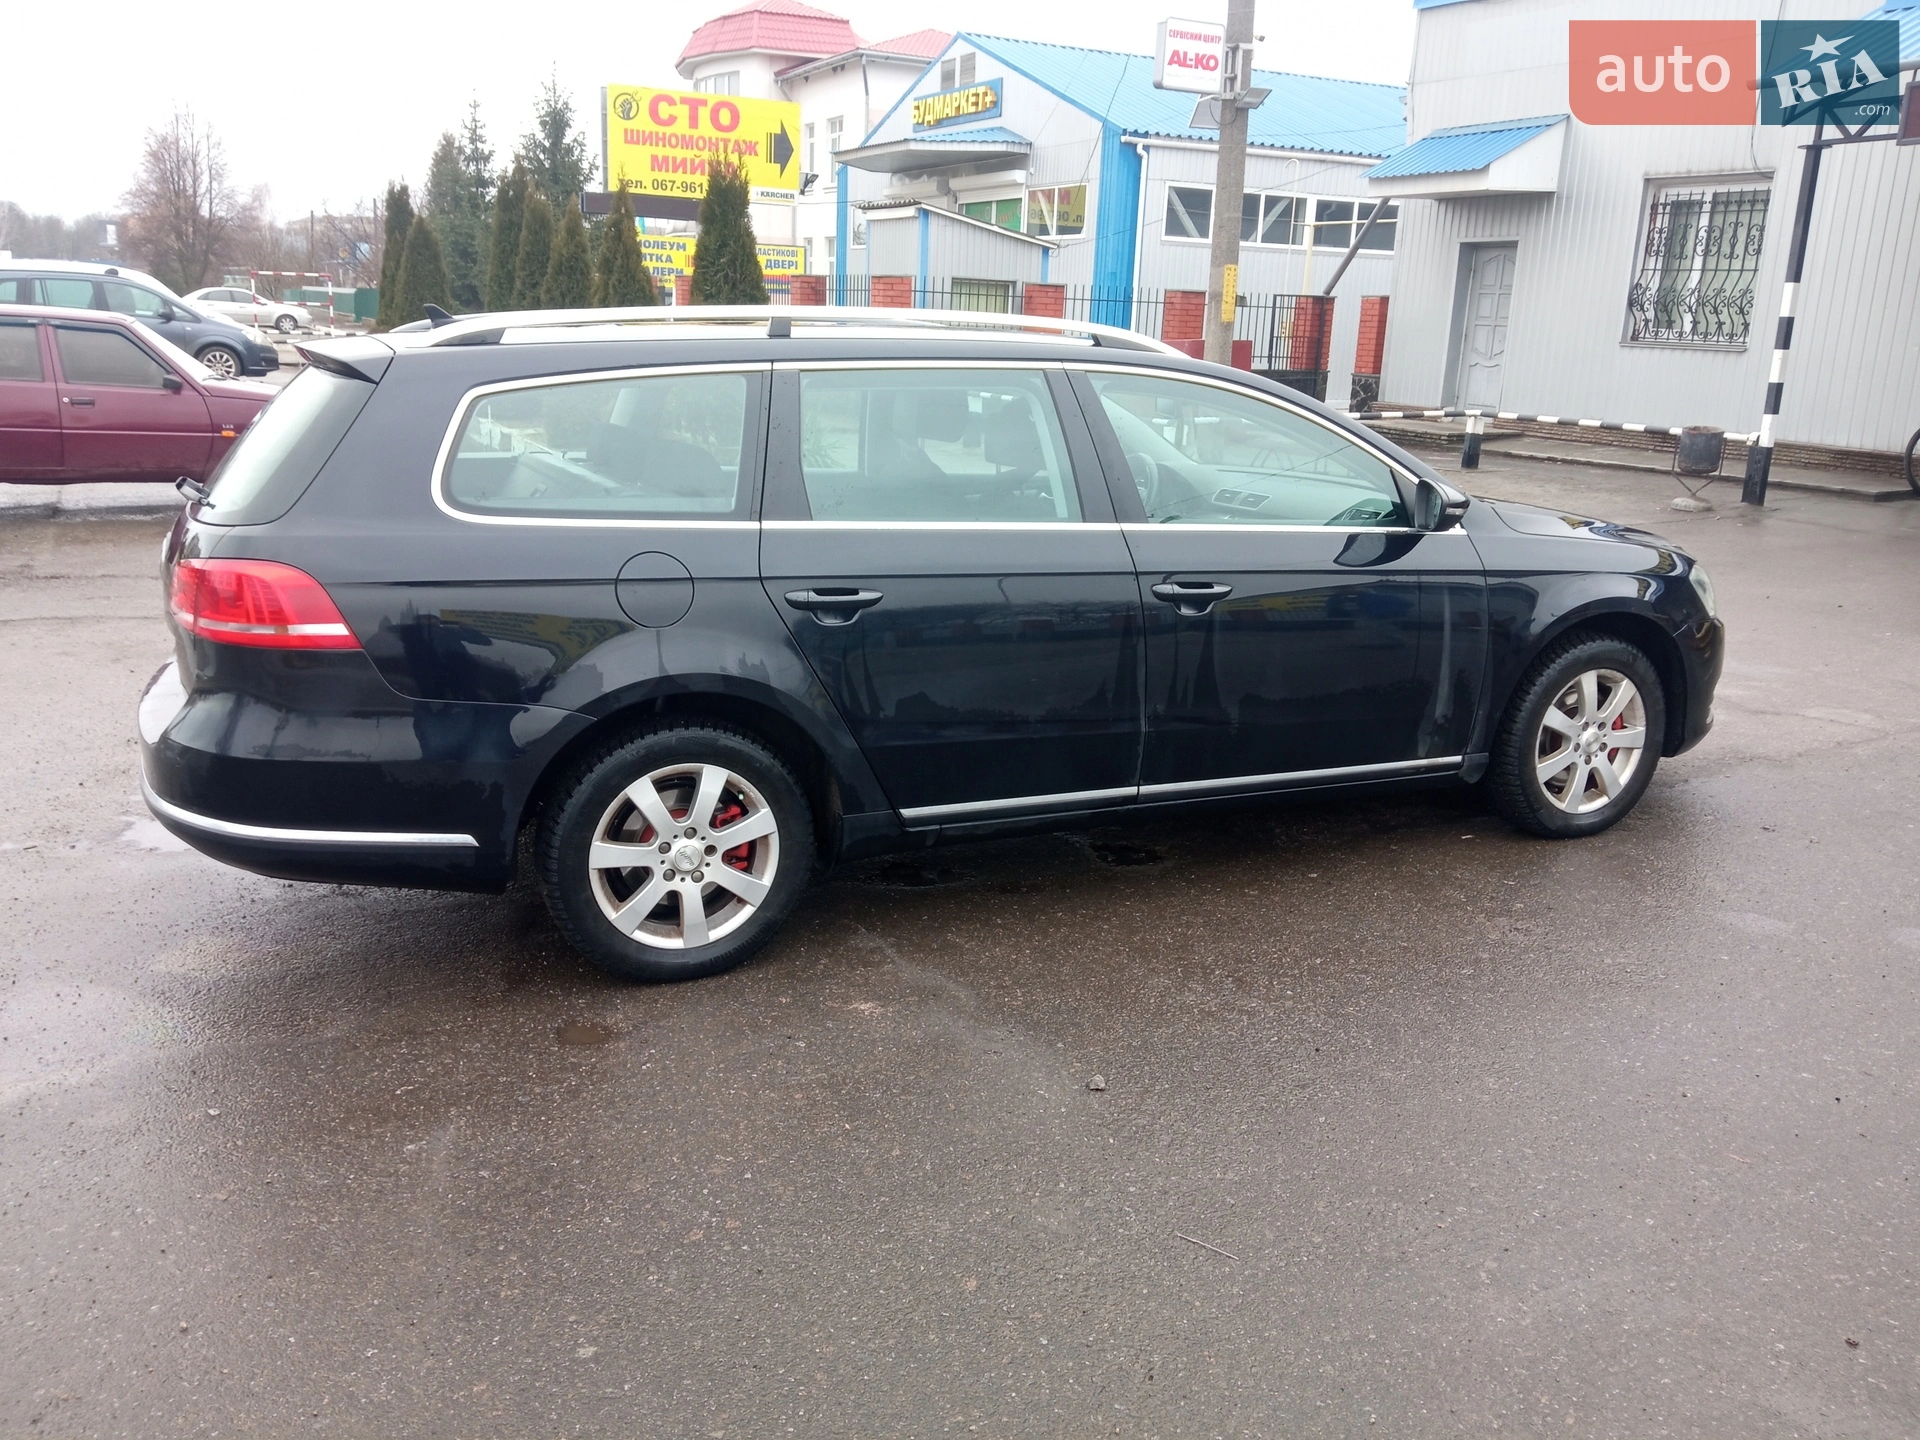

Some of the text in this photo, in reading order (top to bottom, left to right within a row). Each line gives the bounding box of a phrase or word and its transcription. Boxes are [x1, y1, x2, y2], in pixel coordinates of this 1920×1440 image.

[1203, 34, 1222, 44] ЦЕНТР
[1167, 49, 1219, 72] AL-KO
[648, 93, 741, 133] СТО
[623, 127, 759, 157] ШИНОМОНТАЖ
[757, 247, 798, 258] ЛАСТИКОВІ
[641, 253, 673, 264] ИТКА
[765, 258, 798, 270] ДВЕРІ
[652, 266, 684, 277] ЛЕРИ
